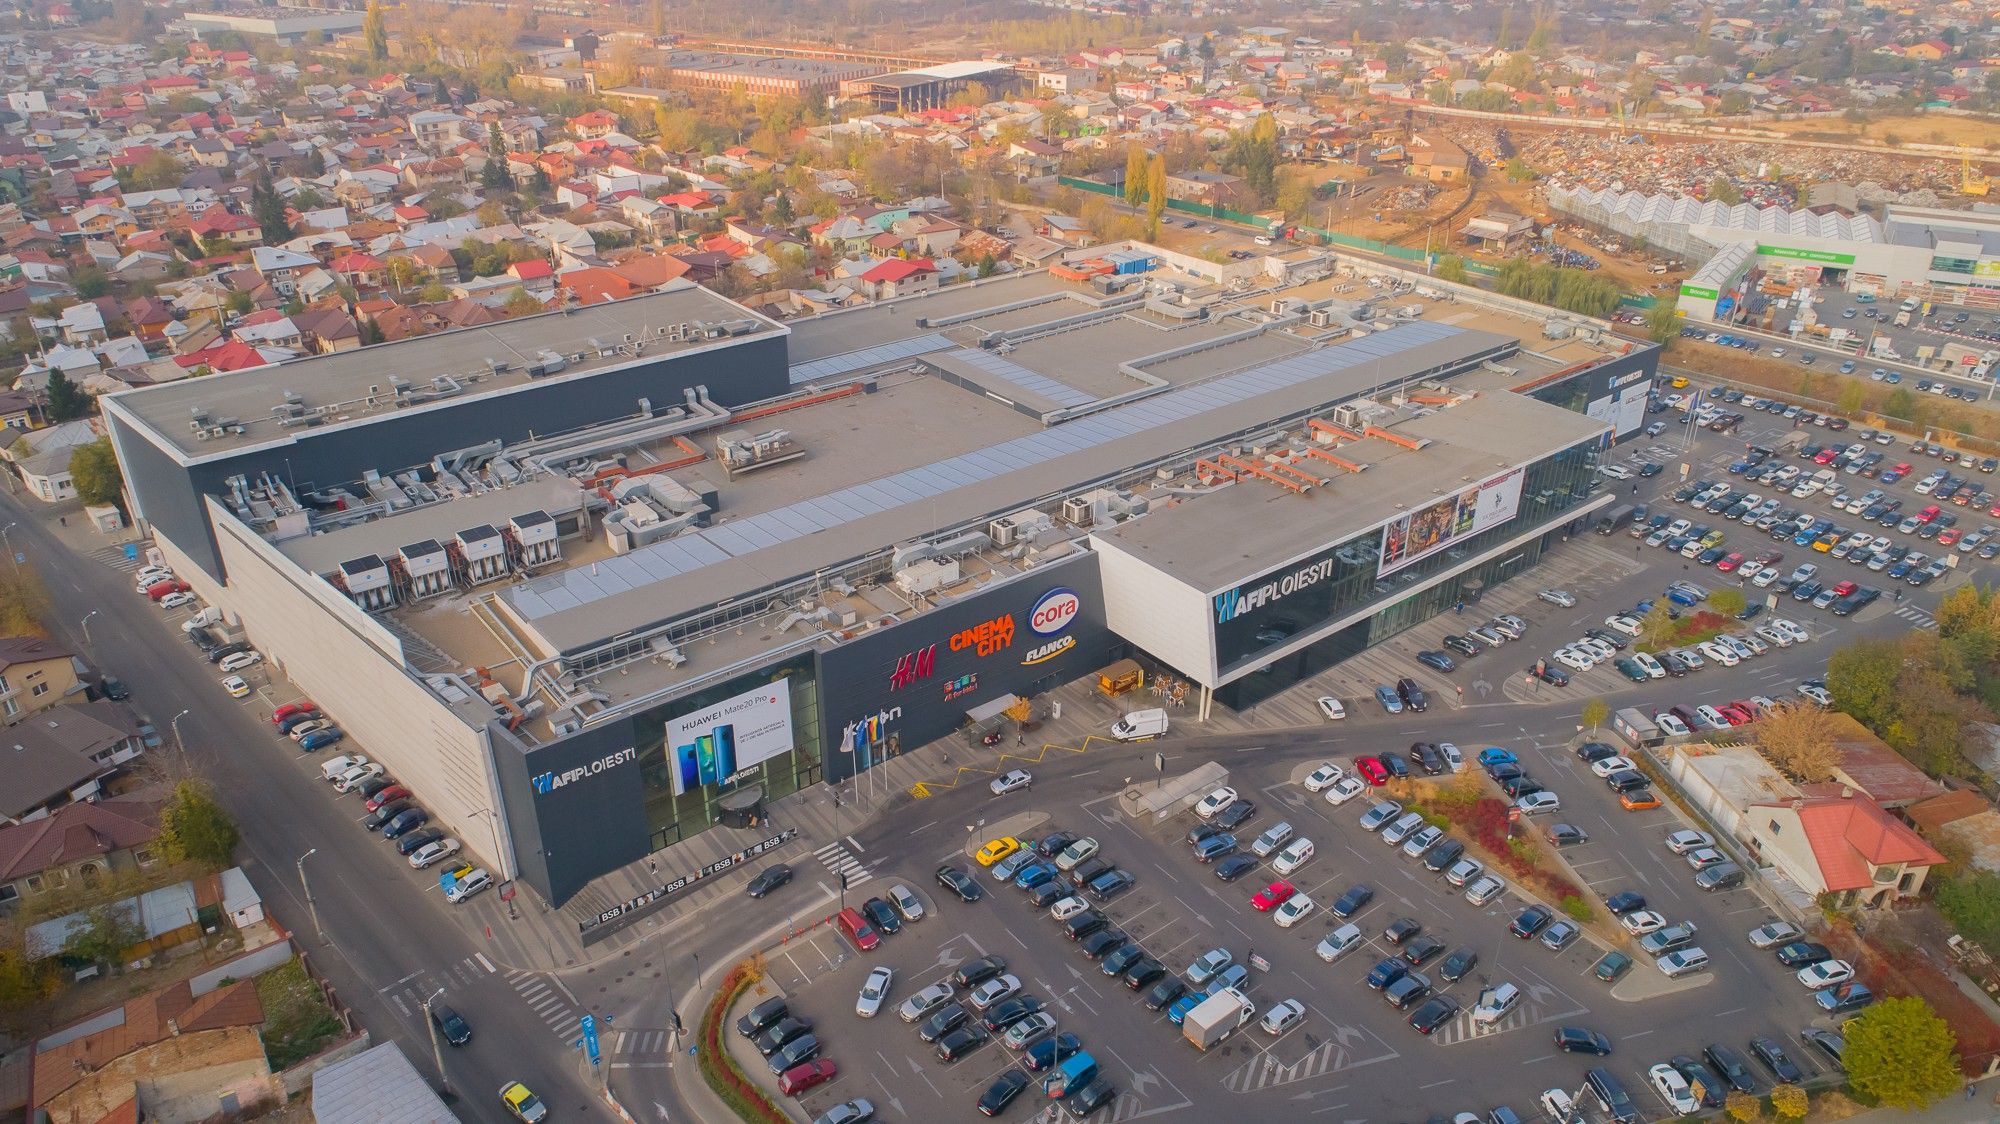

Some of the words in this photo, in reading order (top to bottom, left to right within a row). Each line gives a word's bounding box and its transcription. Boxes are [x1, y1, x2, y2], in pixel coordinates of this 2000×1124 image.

[1033, 599, 1076, 628] cora
[949, 613, 1015, 652] CINEMA
[977, 628, 1015, 657] CITY
[1025, 635, 1073, 662] FLANCO
[889, 643, 937, 692] H&M
[681, 711, 722, 732] HUAWEI
[754, 695, 768, 704] Pro
[763, 836, 780, 849] BSB
[714, 858, 731, 871] BSB
[667, 879, 685, 892] BSB
[601, 907, 620, 922] BSB
